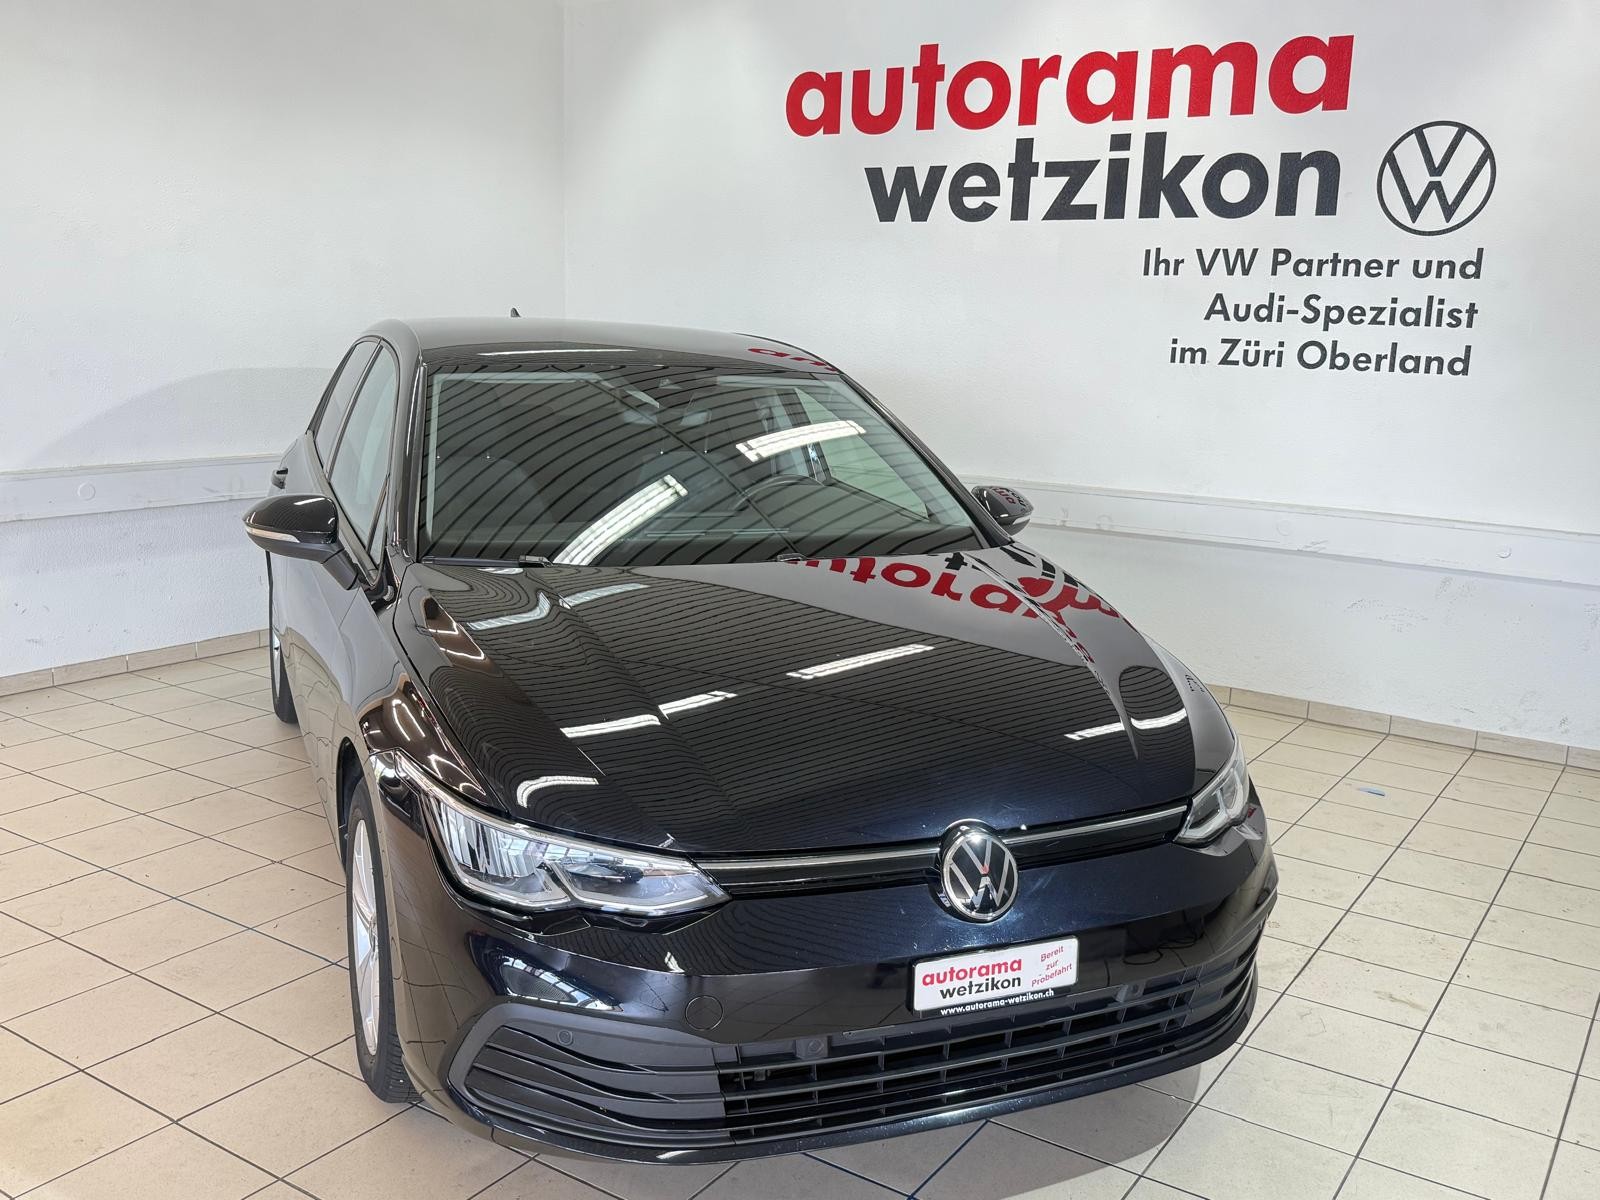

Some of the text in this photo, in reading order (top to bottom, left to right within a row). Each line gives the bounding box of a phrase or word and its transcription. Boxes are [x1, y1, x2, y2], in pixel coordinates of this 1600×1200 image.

[785, 35, 1355, 137] autorama
[865, 132, 1341, 223] wetzikon
[1143, 247, 1485, 280] Ihr VW Partner und
[1203, 292, 1479, 332] Audi-Spezialist
[1170, 338, 1472, 376] im Züri Oberland
[1040, 945, 1064, 963] Bereit
[1045, 959, 1059, 971] zur
[921, 958, 1023, 987] autorama
[1031, 963, 1073, 988] Probefahrt
[939, 976, 1022, 999] wetzikon
[940, 988, 1055, 1016] www.autorama-wetzikon.ch
